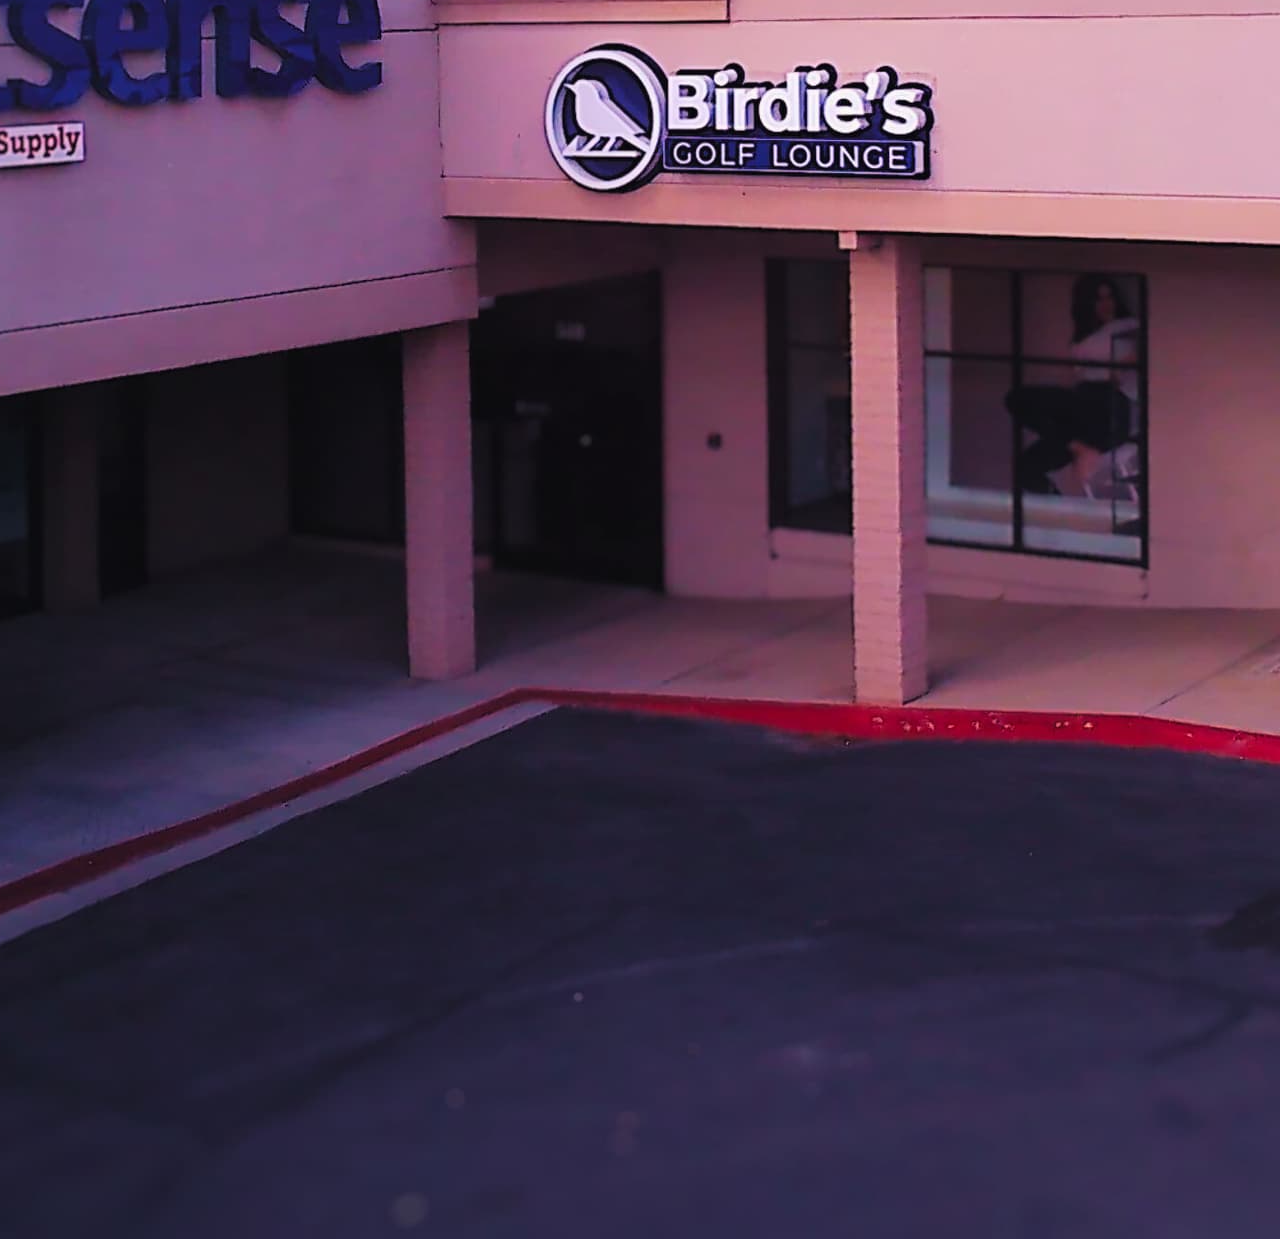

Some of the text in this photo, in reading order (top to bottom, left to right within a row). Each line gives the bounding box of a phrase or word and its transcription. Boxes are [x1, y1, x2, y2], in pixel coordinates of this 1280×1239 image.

[668, 69, 924, 136] Birdie's
[672, 141, 908, 170] GOLF LOUNGE
